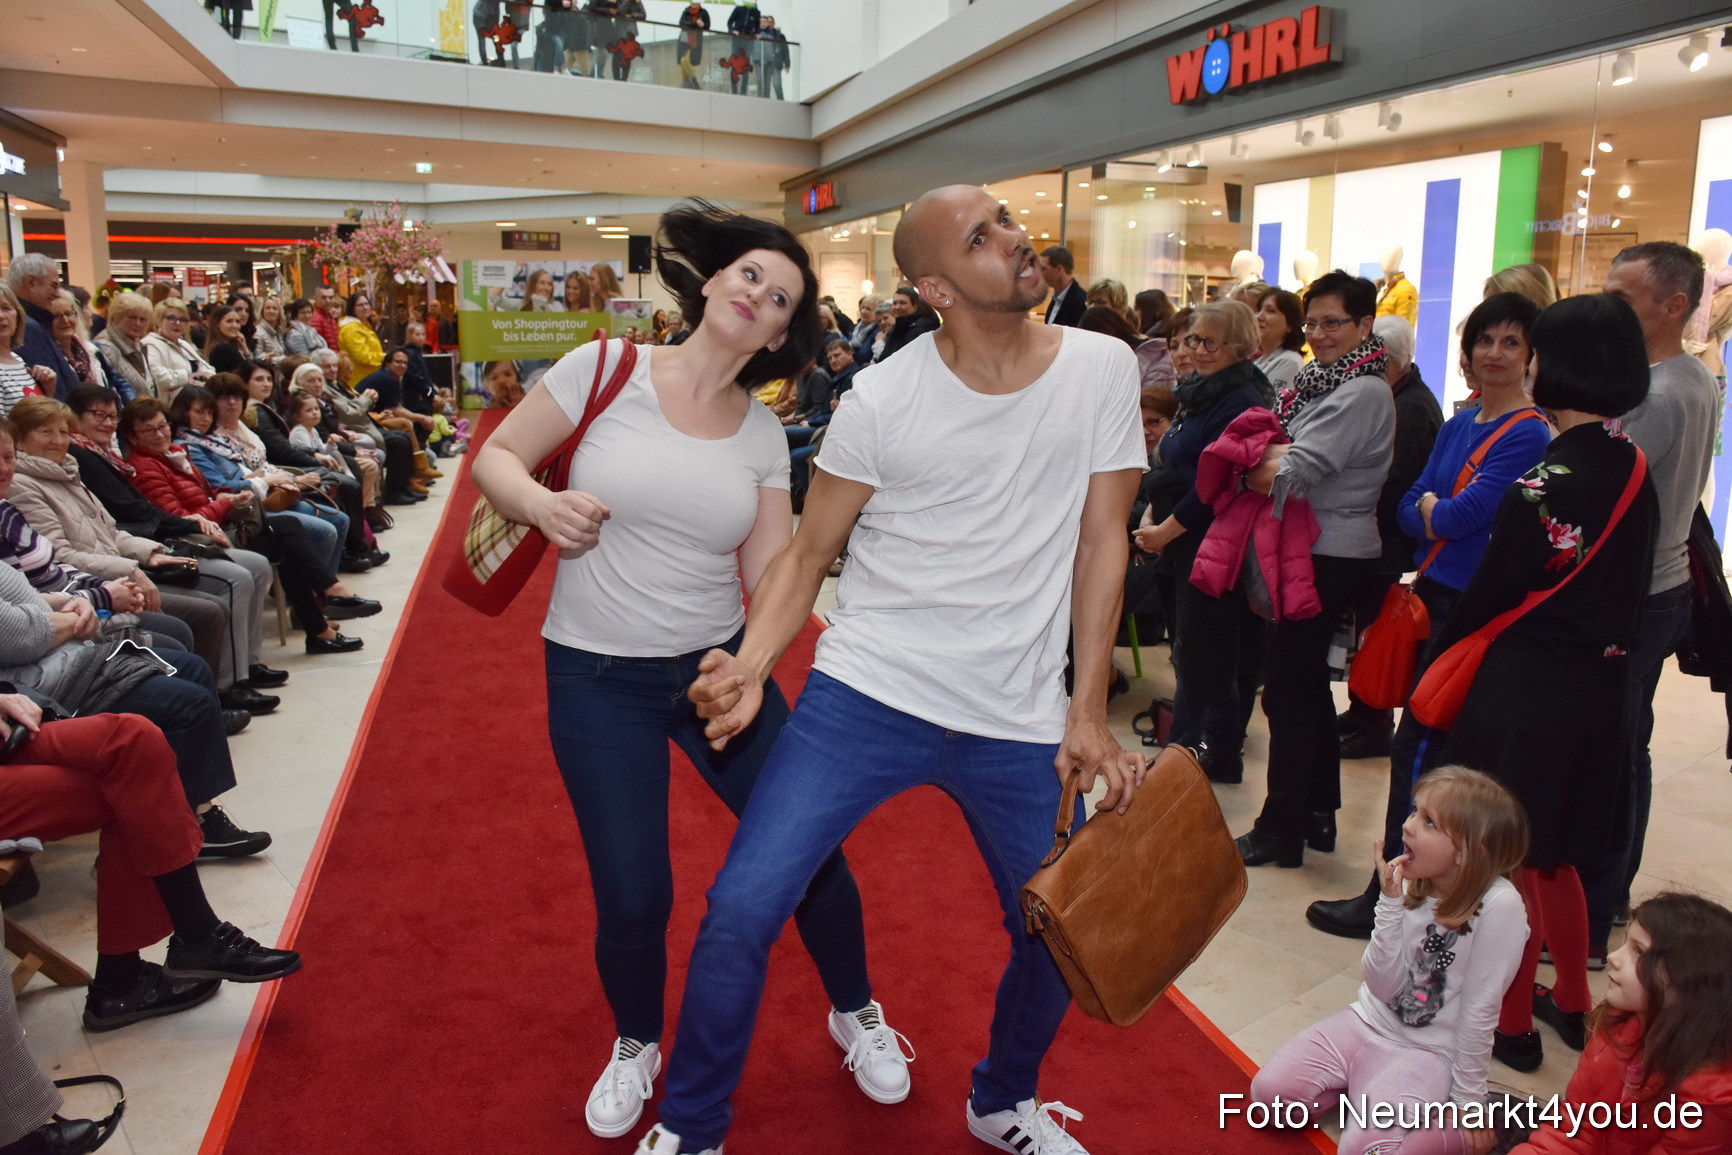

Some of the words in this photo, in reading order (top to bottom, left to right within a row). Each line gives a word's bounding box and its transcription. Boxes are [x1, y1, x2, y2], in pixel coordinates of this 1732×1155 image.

[1166, 5, 1332, 105] WÖHRL
[492, 319, 512, 329] Von
[514, 318, 588, 331] Shoppingtour
[503, 331, 519, 341] bis
[521, 331, 554, 341] Leben
[556, 332, 577, 343] pur.
